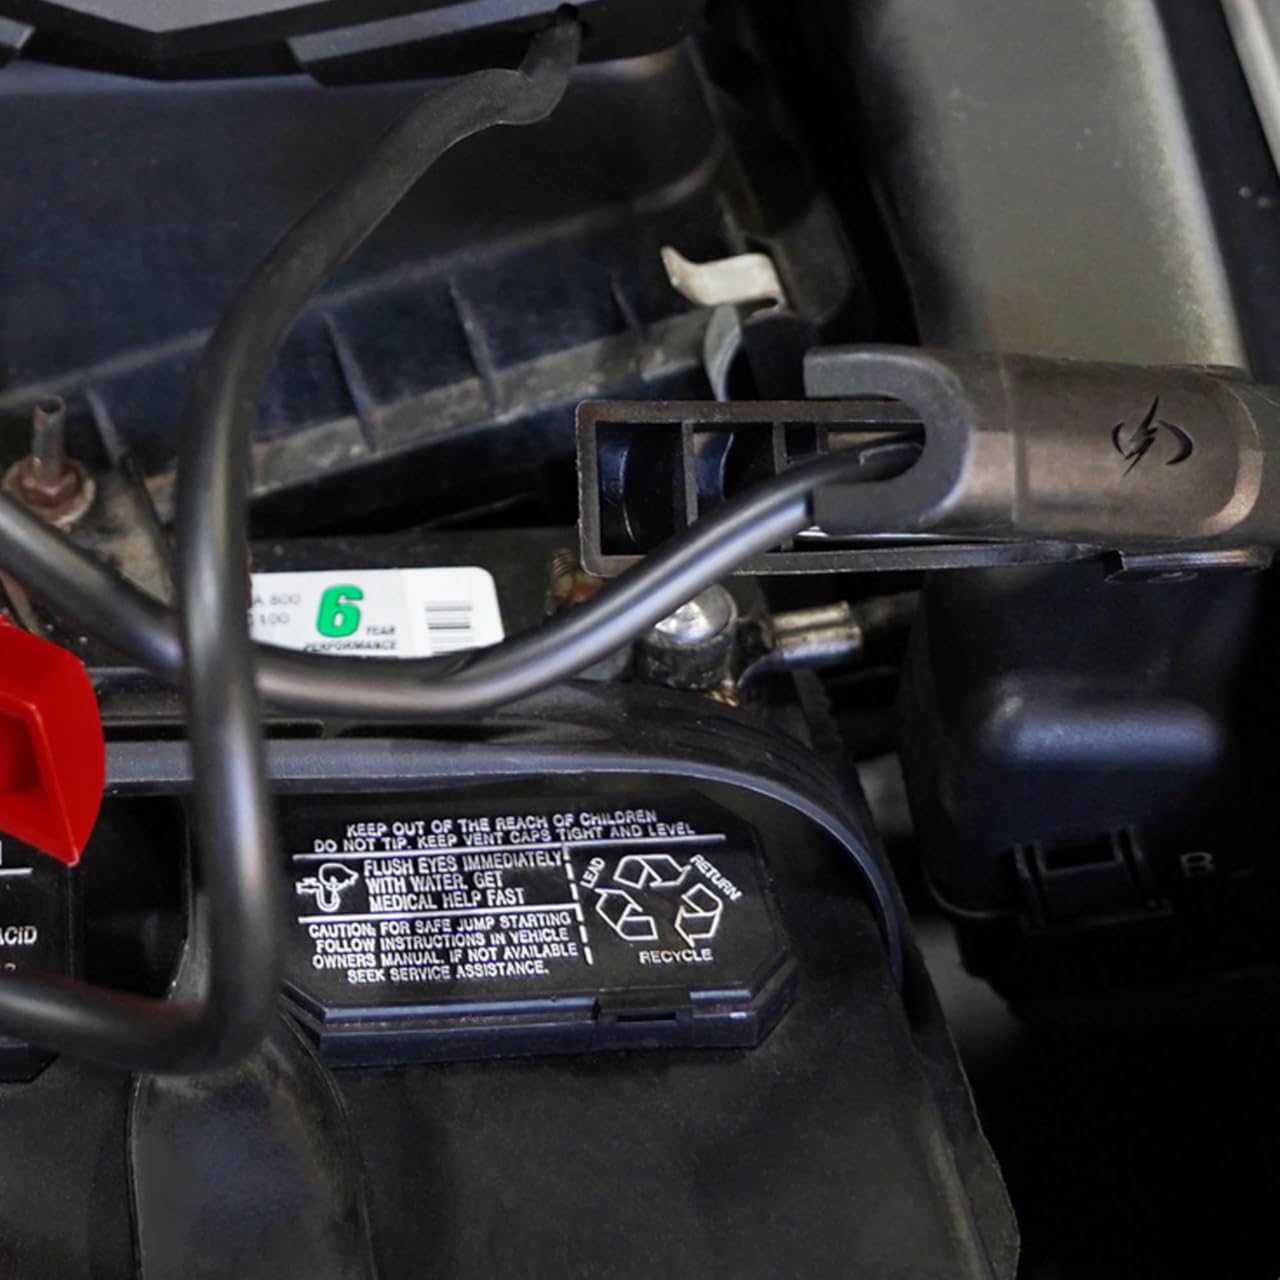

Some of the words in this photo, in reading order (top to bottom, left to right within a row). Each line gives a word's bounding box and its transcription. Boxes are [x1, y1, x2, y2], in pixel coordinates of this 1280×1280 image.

[316, 583, 365, 638] 6
[366, 624, 397, 636] YEAR
[314, 839, 337, 853] DO
[343, 837, 376, 852] NOT
[381, 835, 412, 851] TIP.
[417, 833, 458, 849] KEEP
[463, 831, 505, 846] VENT
[509, 828, 552, 844] CAPS
[556, 826, 603, 841] TIGHT
[609, 824, 643, 838] AND
[648, 821, 696, 837] LEVEL
[346, 822, 387, 838] KEEP
[392, 821, 425, 836] OUT
[431, 819, 453, 834] OF
[457, 818, 490, 833] THE
[495, 816, 548, 831] REACH
[553, 813, 574, 828] OF
[579, 809, 658, 826] CHILDREN
[363, 858, 413, 877] FLUSH
[418, 856, 458, 874] EYES
[462, 850, 562, 871] IMMEDIATELY
[579, 856, 606, 889] LEAD
[365, 876, 406, 894] WITH
[410, 873, 468, 893] WATER.
[473, 870, 504, 888] GET
[689, 853, 744, 902] RETURN
[368, 893, 438, 912] MEDICAL
[442, 890, 482, 909] HELP
[486, 887, 525, 907] FAST
[308, 922, 376, 939] CAUTION:
[380, 920, 411, 936] FOR
[415, 919, 452, 934] SAFE
[456, 917, 495, 933] JUMP
[499, 911, 571, 930] STARTING
[316, 937, 376, 954] FOLLOW
[380, 932, 486, 951] INSTRUCTIONS
[490, 931, 507, 946] IN
[511, 927, 569, 944] VEHICLE
[312, 953, 376, 970] OWNERS
[381, 949, 445, 967] MANUAL.
[449, 947, 463, 963] IF
[468, 946, 498, 962] NOT
[503, 942, 579, 961] AVAILABLE
[638, 948, 714, 965] RECYCLE
[347, 969, 385, 985] SEEK
[390, 965, 451, 982] SERVICE
[456, 960, 549, 979] ASSISTANCE.
